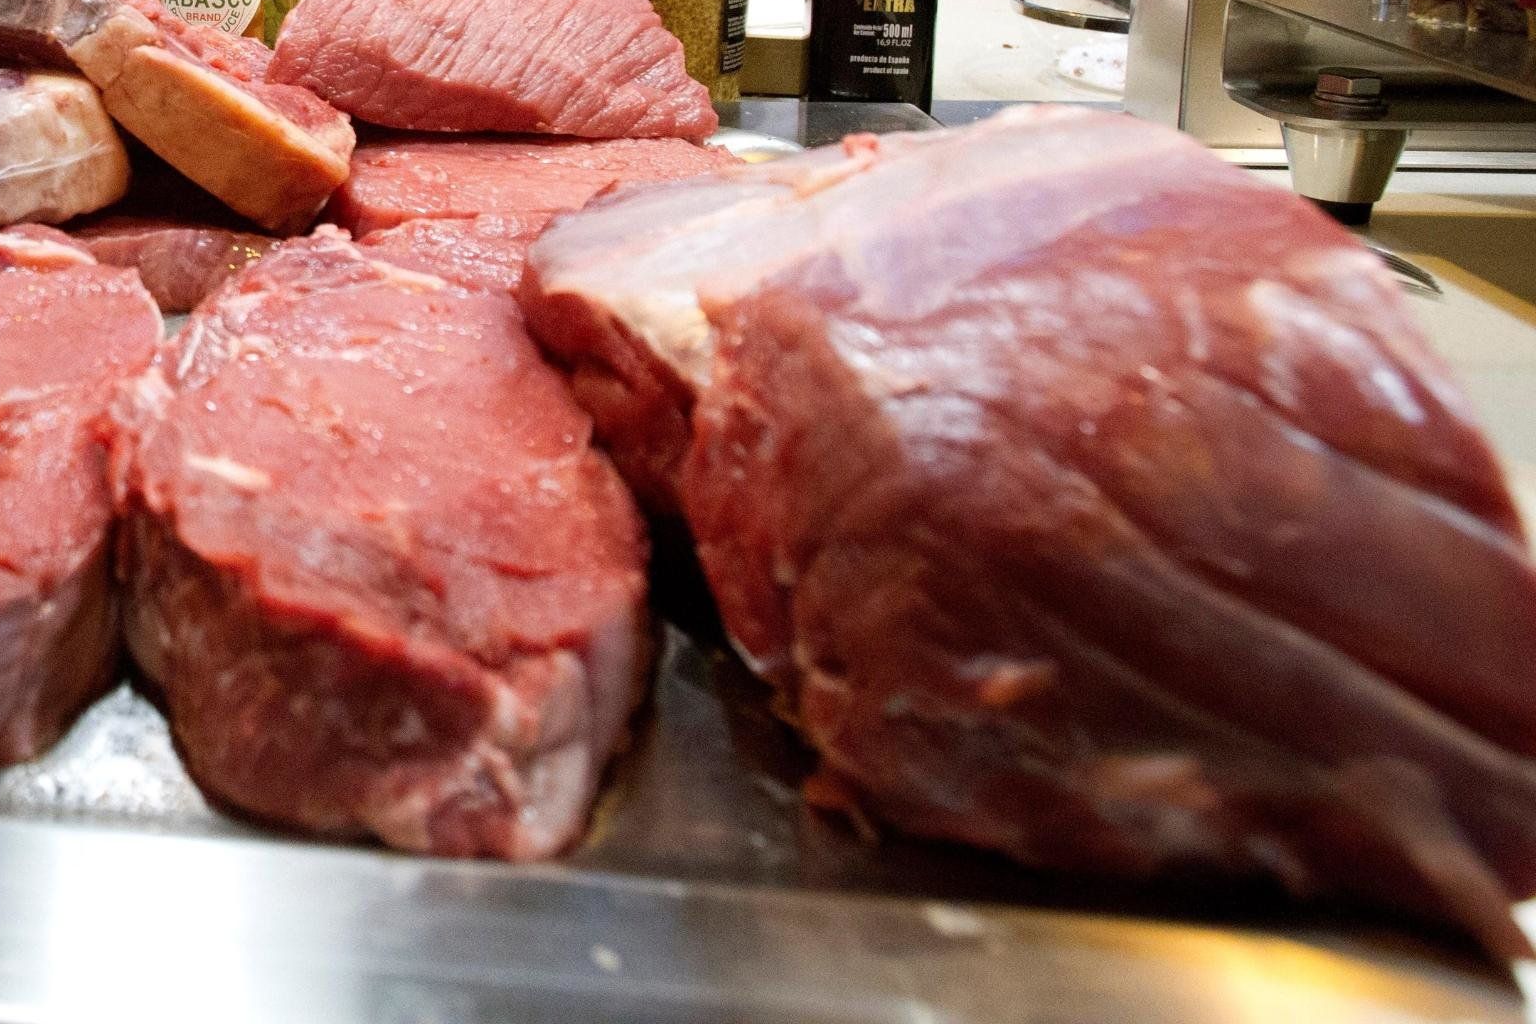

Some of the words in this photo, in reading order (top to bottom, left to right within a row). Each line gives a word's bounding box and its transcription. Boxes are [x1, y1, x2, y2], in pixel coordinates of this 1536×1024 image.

[185, 12, 222, 23] BRAND
[221, 10, 240, 33] UCE
[883, 24, 900, 38] 500
[901, 24, 913, 38] ml
[850, 54, 878, 64] producto
